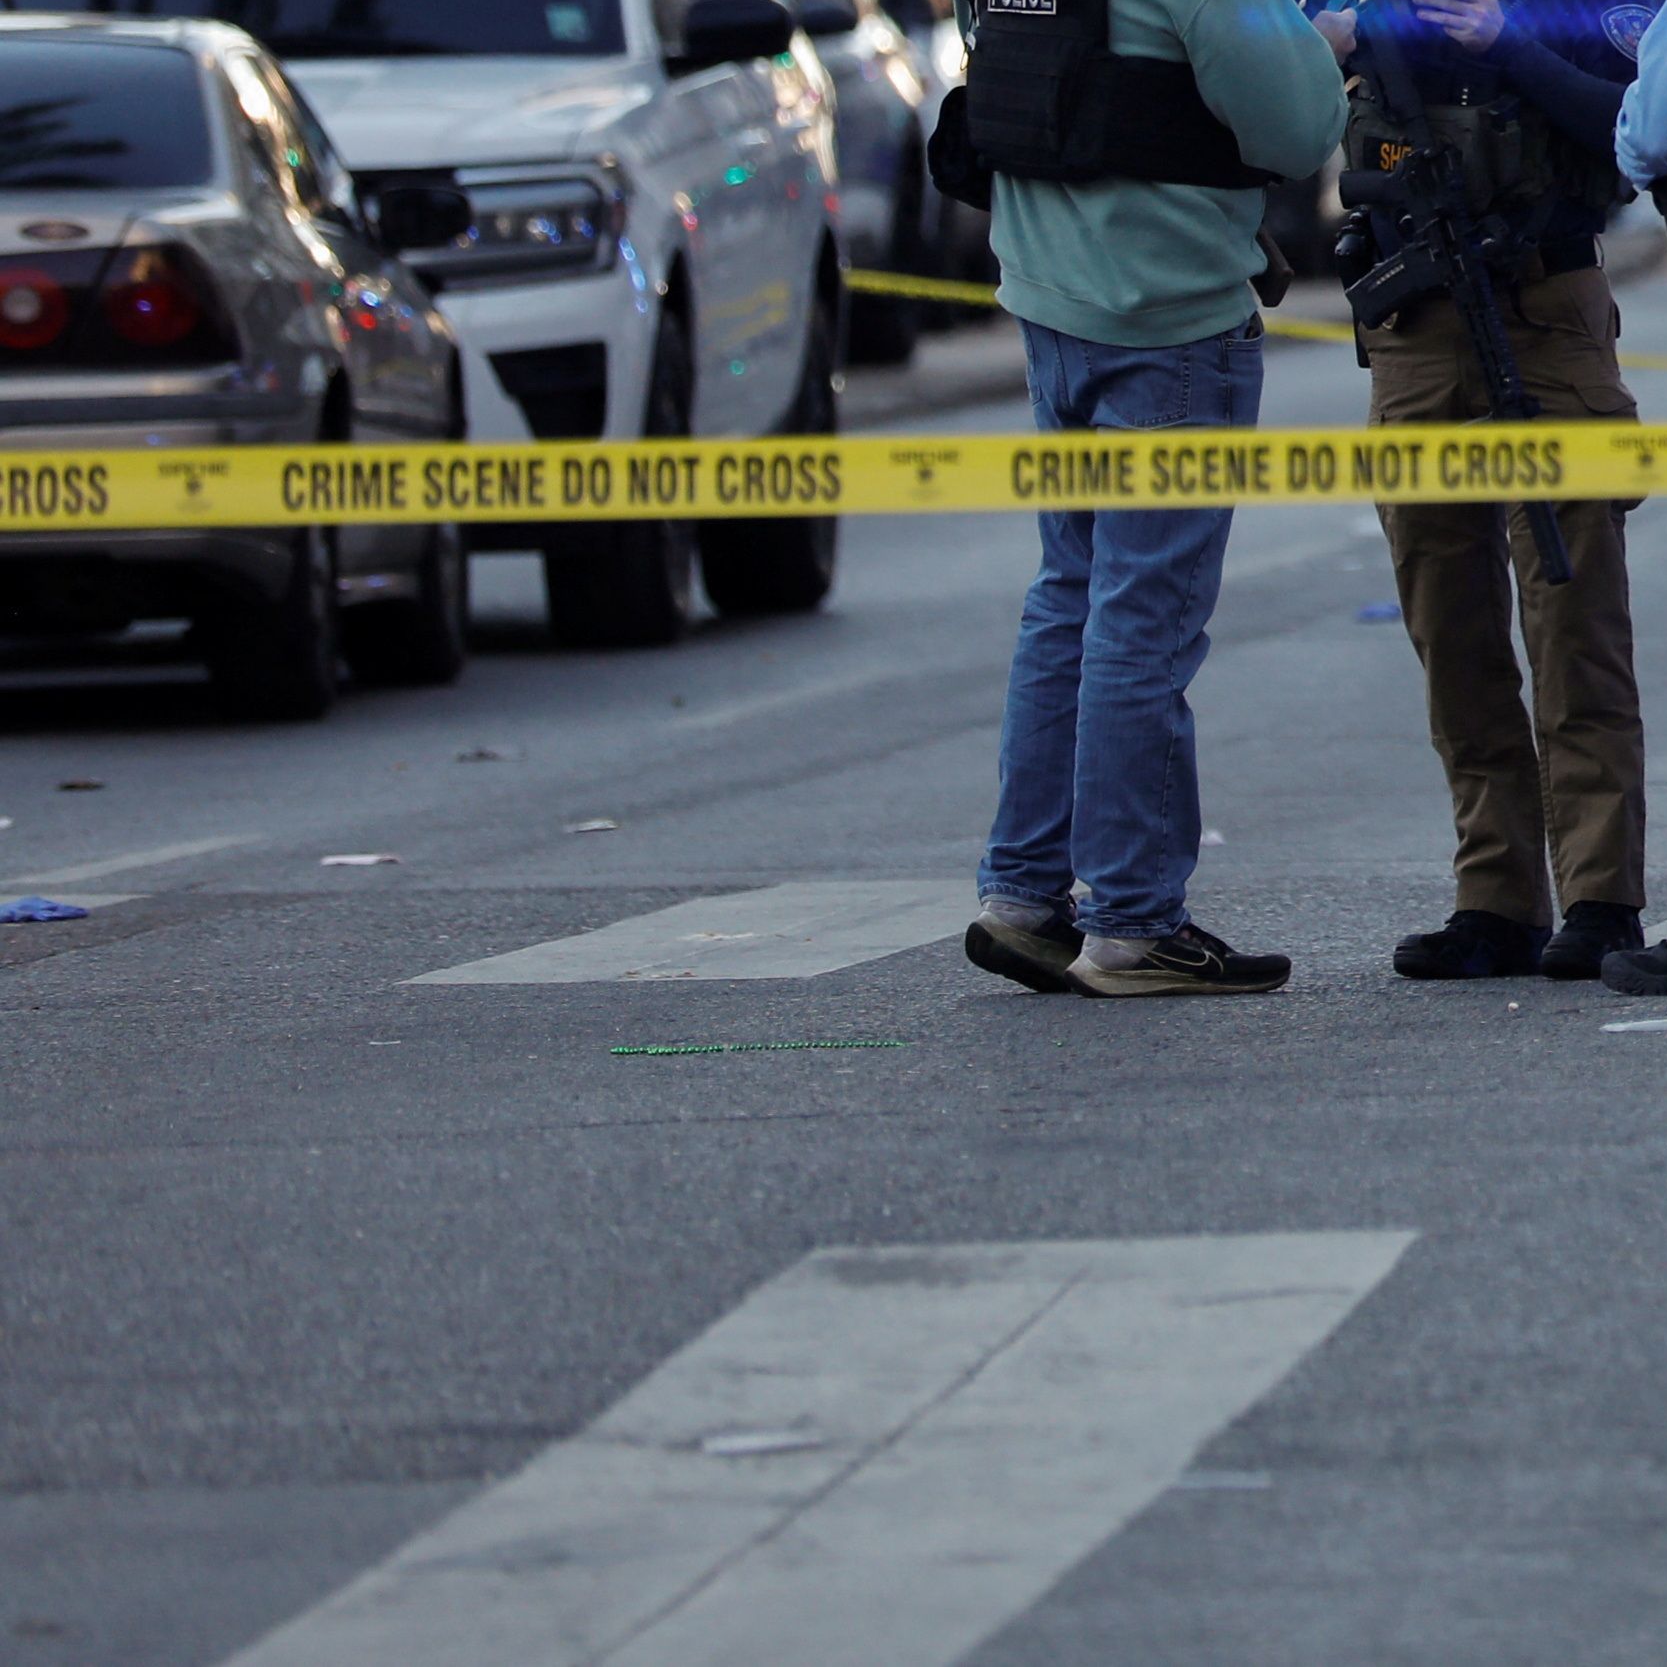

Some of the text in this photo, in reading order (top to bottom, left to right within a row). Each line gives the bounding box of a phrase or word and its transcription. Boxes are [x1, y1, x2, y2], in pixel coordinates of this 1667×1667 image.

[0, 463, 109, 518] ROSS
[281, 452, 843, 512] CRIME SCENE DO NOT CROSS
[1010, 439, 1564, 499] CRIME SCENE DO NOT CROSS
